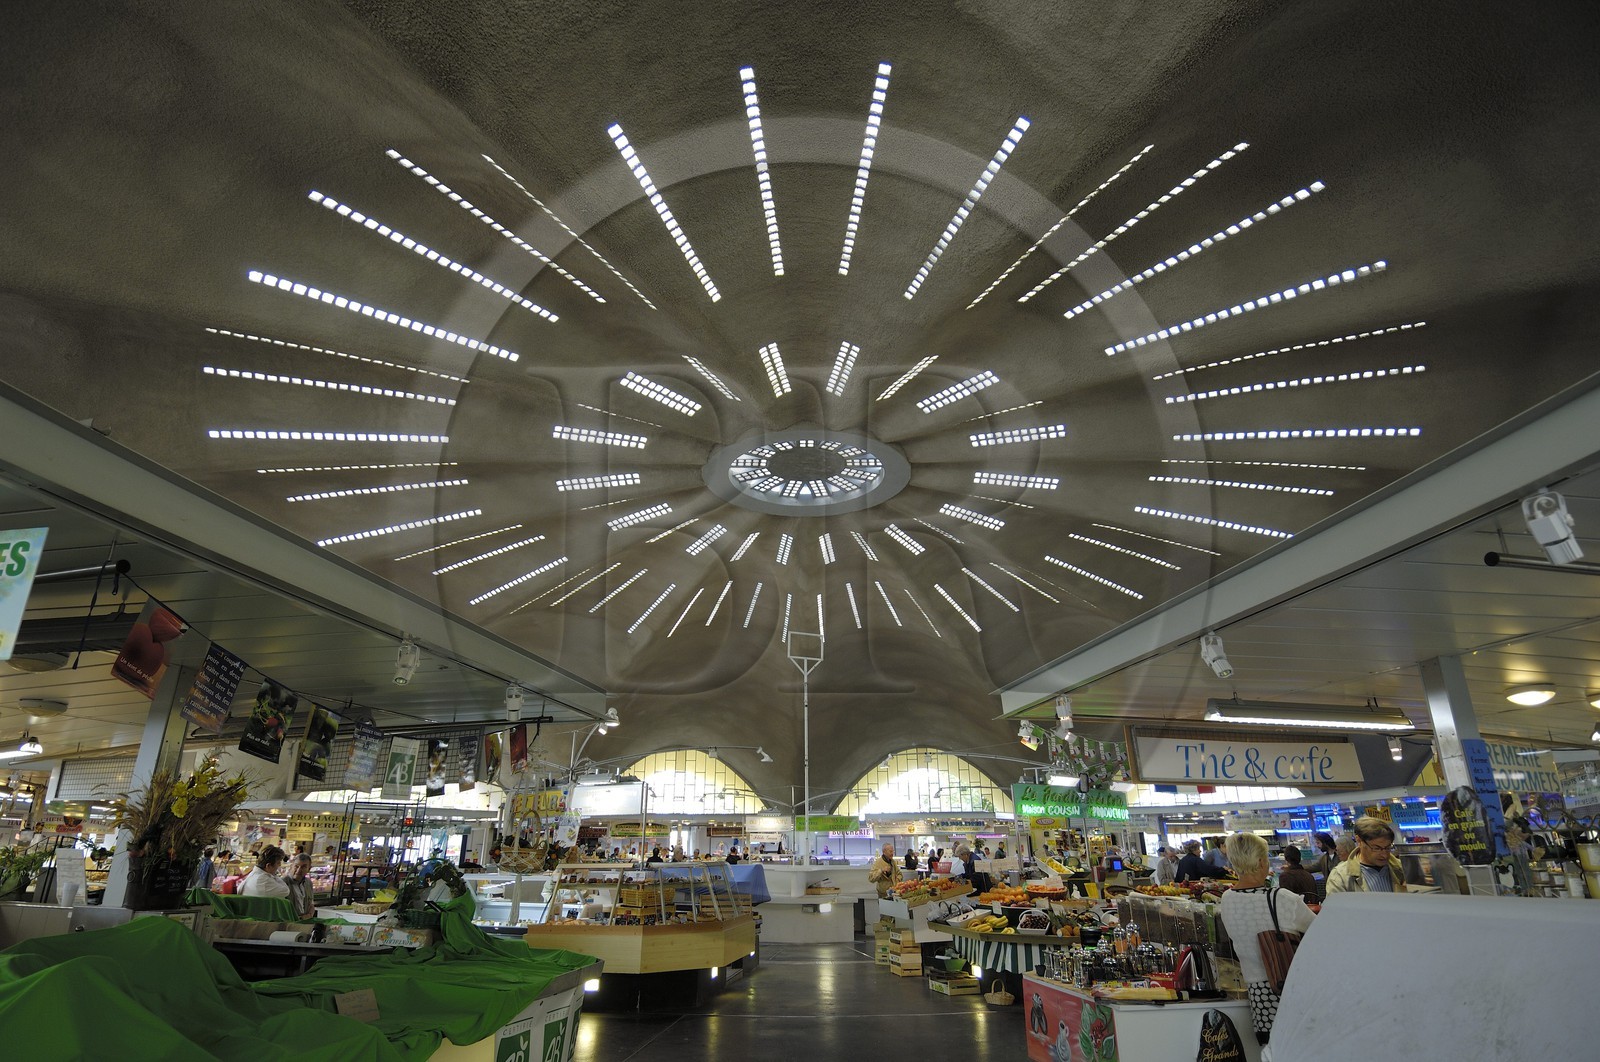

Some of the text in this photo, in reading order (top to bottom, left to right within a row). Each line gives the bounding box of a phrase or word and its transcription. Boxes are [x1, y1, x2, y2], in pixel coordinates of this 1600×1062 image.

[206, 654, 220, 666] poire
[229, 670, 241, 681] deux
[218, 673, 230, 684] dans
[194, 680, 214, 696] marrons
[1176, 743, 1334, 782] Thé & café
[388, 761, 408, 783] AB
[1494, 771, 1560, 793] GOURMETS
[1021, 786, 1036, 802] Le
[1022, 803, 1046, 814] Maison
[1048, 805, 1080, 816] COUSIN
[832, 828, 871, 836] BOUCHERIE
[1461, 820, 1485, 831] grains
[1460, 841, 1487, 851] moulu
